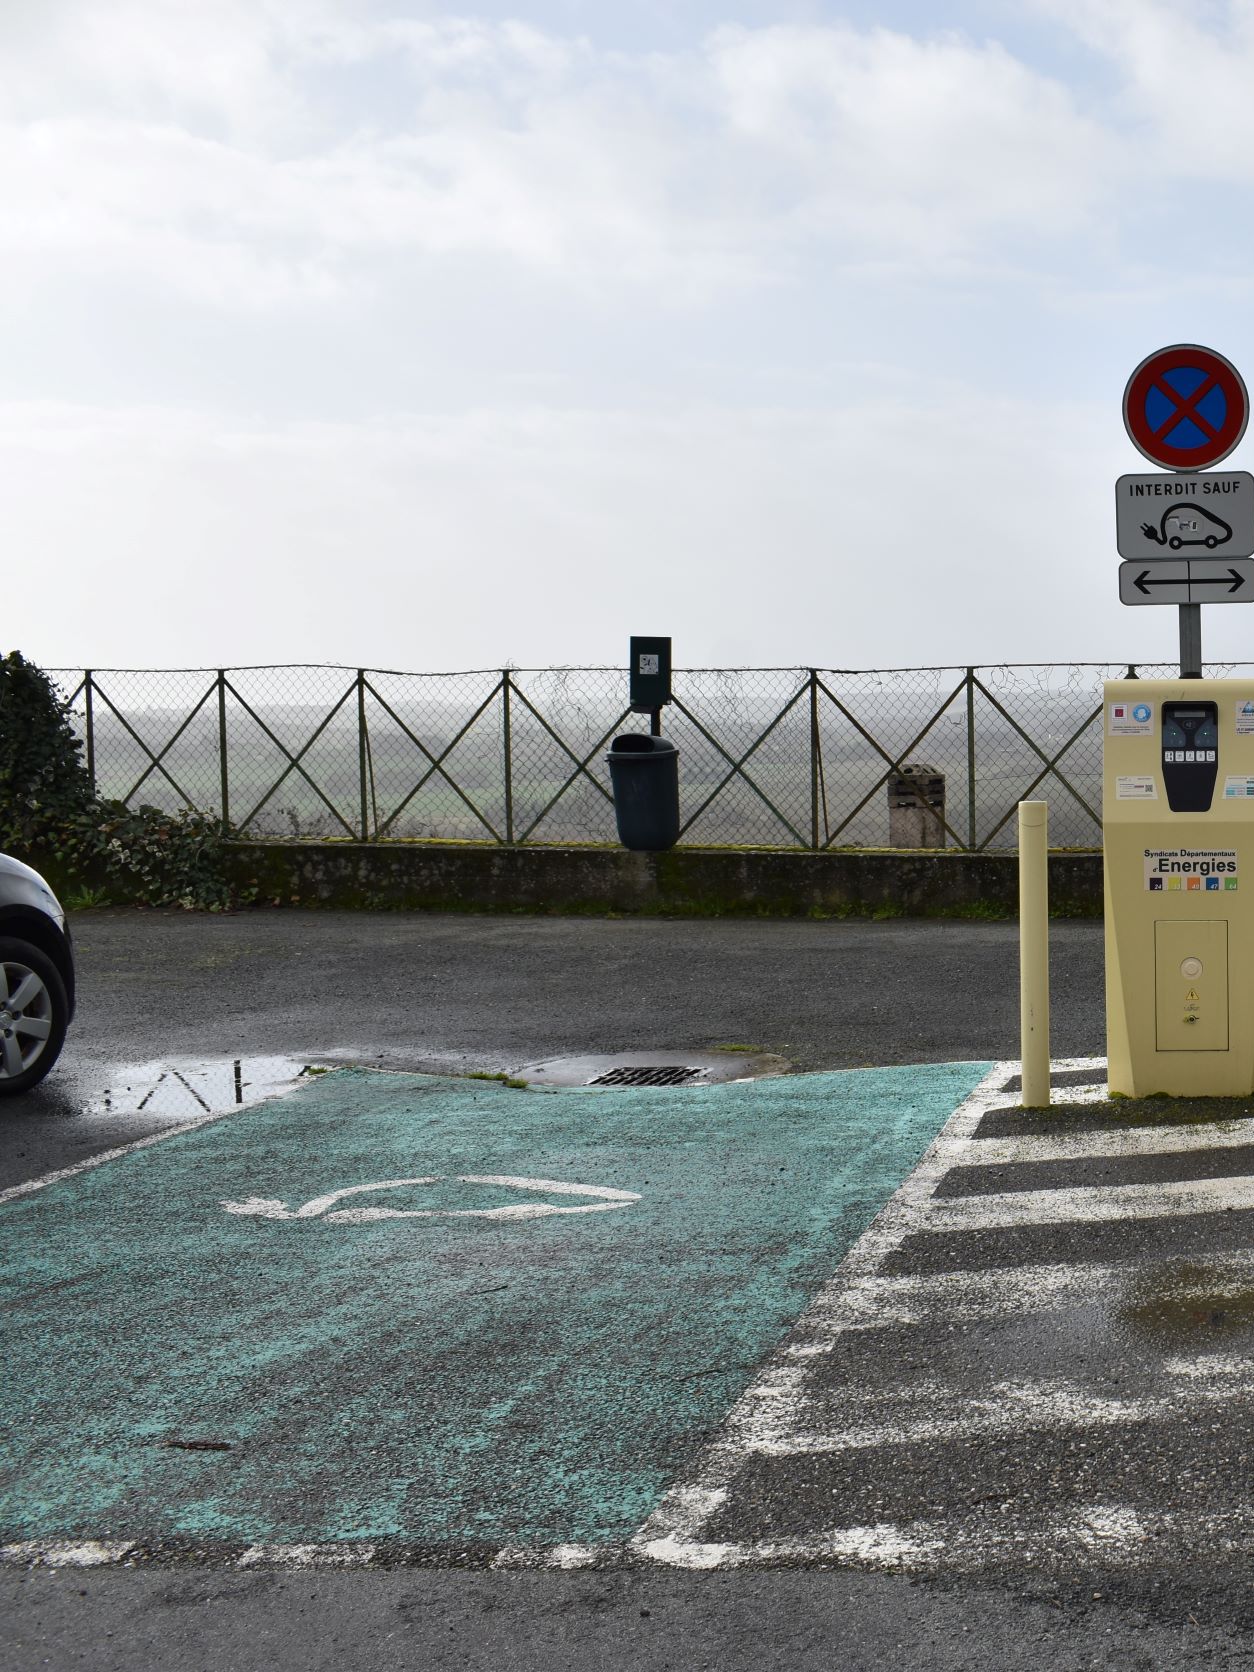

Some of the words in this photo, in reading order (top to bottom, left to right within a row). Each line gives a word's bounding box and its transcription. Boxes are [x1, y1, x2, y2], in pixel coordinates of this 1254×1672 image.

[1129, 482, 1197, 497] INTERDIT
[1202, 481, 1241, 495] SAUF
[1144, 849, 1178, 858] Syndicats
[1180, 849, 1236, 858] Départementaux
